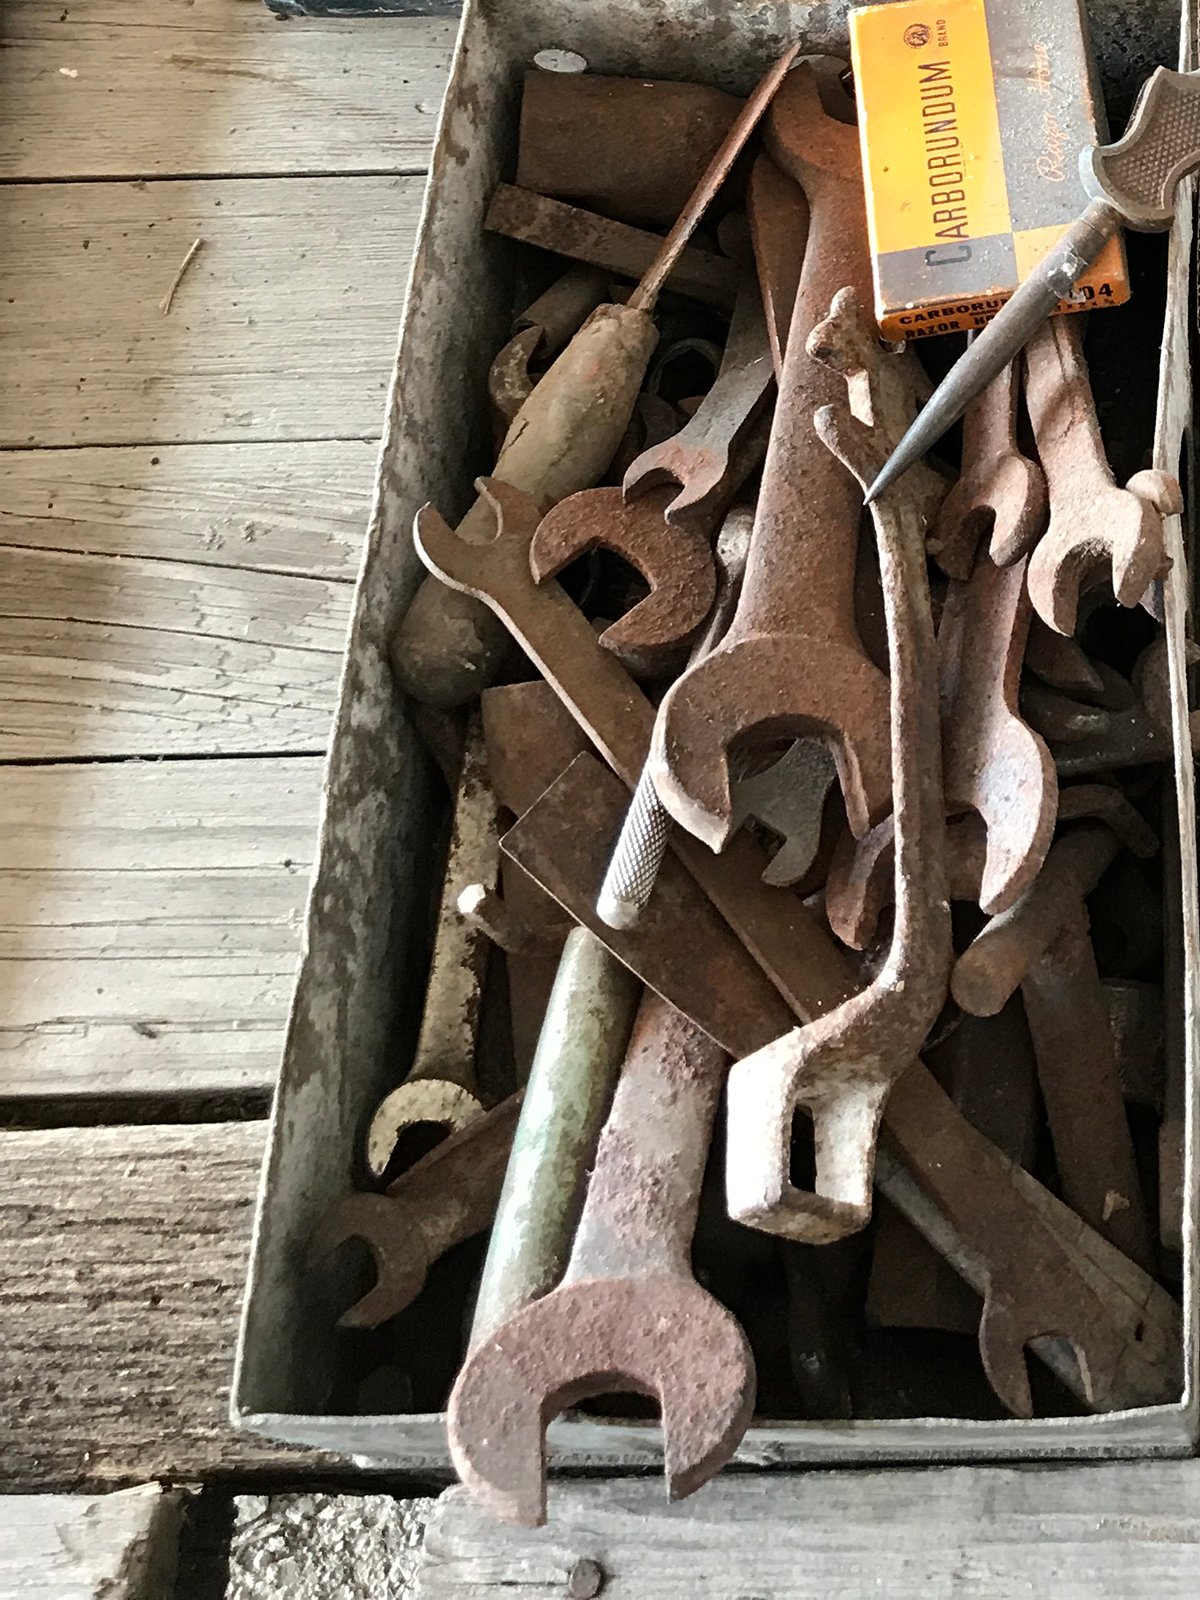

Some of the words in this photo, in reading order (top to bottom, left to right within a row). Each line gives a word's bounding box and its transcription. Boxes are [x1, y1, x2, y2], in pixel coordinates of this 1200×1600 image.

[936, 19, 949, 47] BRAND
[918, 60, 973, 267] CARBORUNDUM
[904, 320, 961, 340] RAZOR
